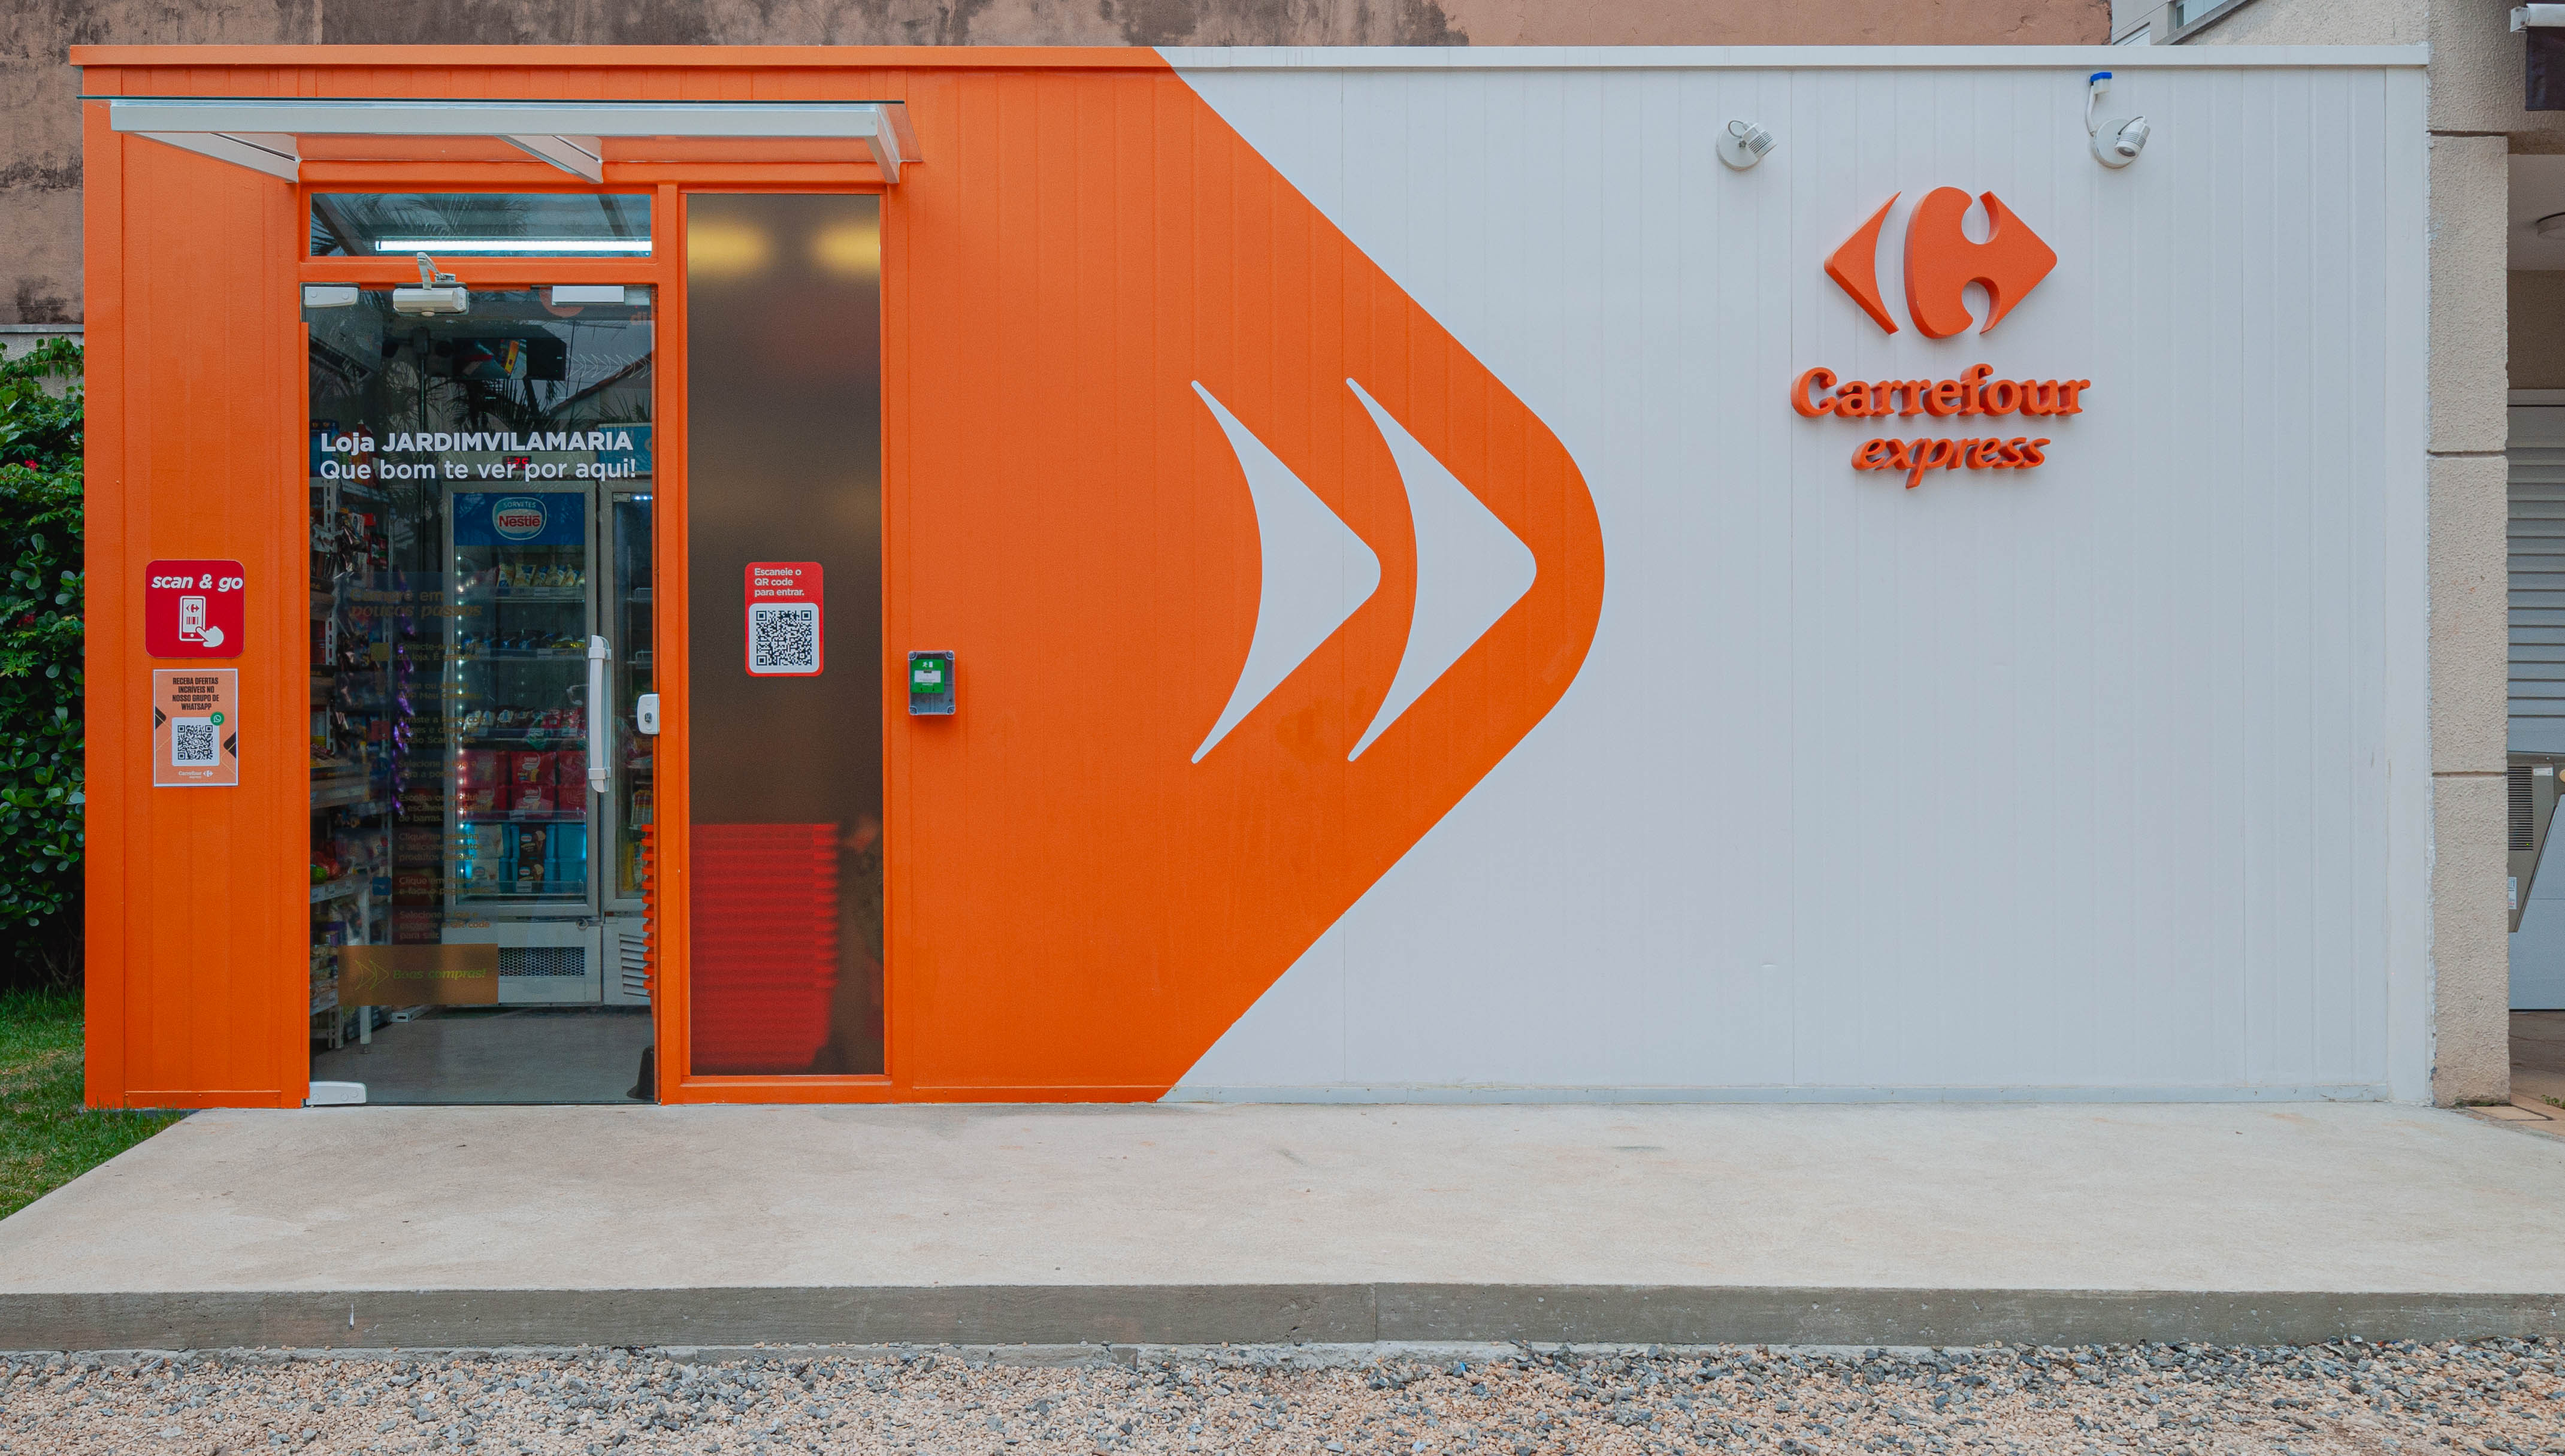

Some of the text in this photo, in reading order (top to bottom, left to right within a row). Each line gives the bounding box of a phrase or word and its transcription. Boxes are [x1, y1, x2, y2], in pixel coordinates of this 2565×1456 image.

[1791, 364, 2091, 417] Carrefour
[321, 432, 633, 455] Loja JARDIMVILAMARIA
[320, 459, 636, 482] Que bom te ver por aqui!
[1852, 437, 2051, 489] express
[754, 568, 793, 576] Escaneie
[151, 574, 243, 592] scan & go
[754, 578, 769, 586] QR
[419, 591, 444, 602] em
[178, 685, 205, 694] INCRÍVEIS
[393, 968, 487, 980] Boas compras!
